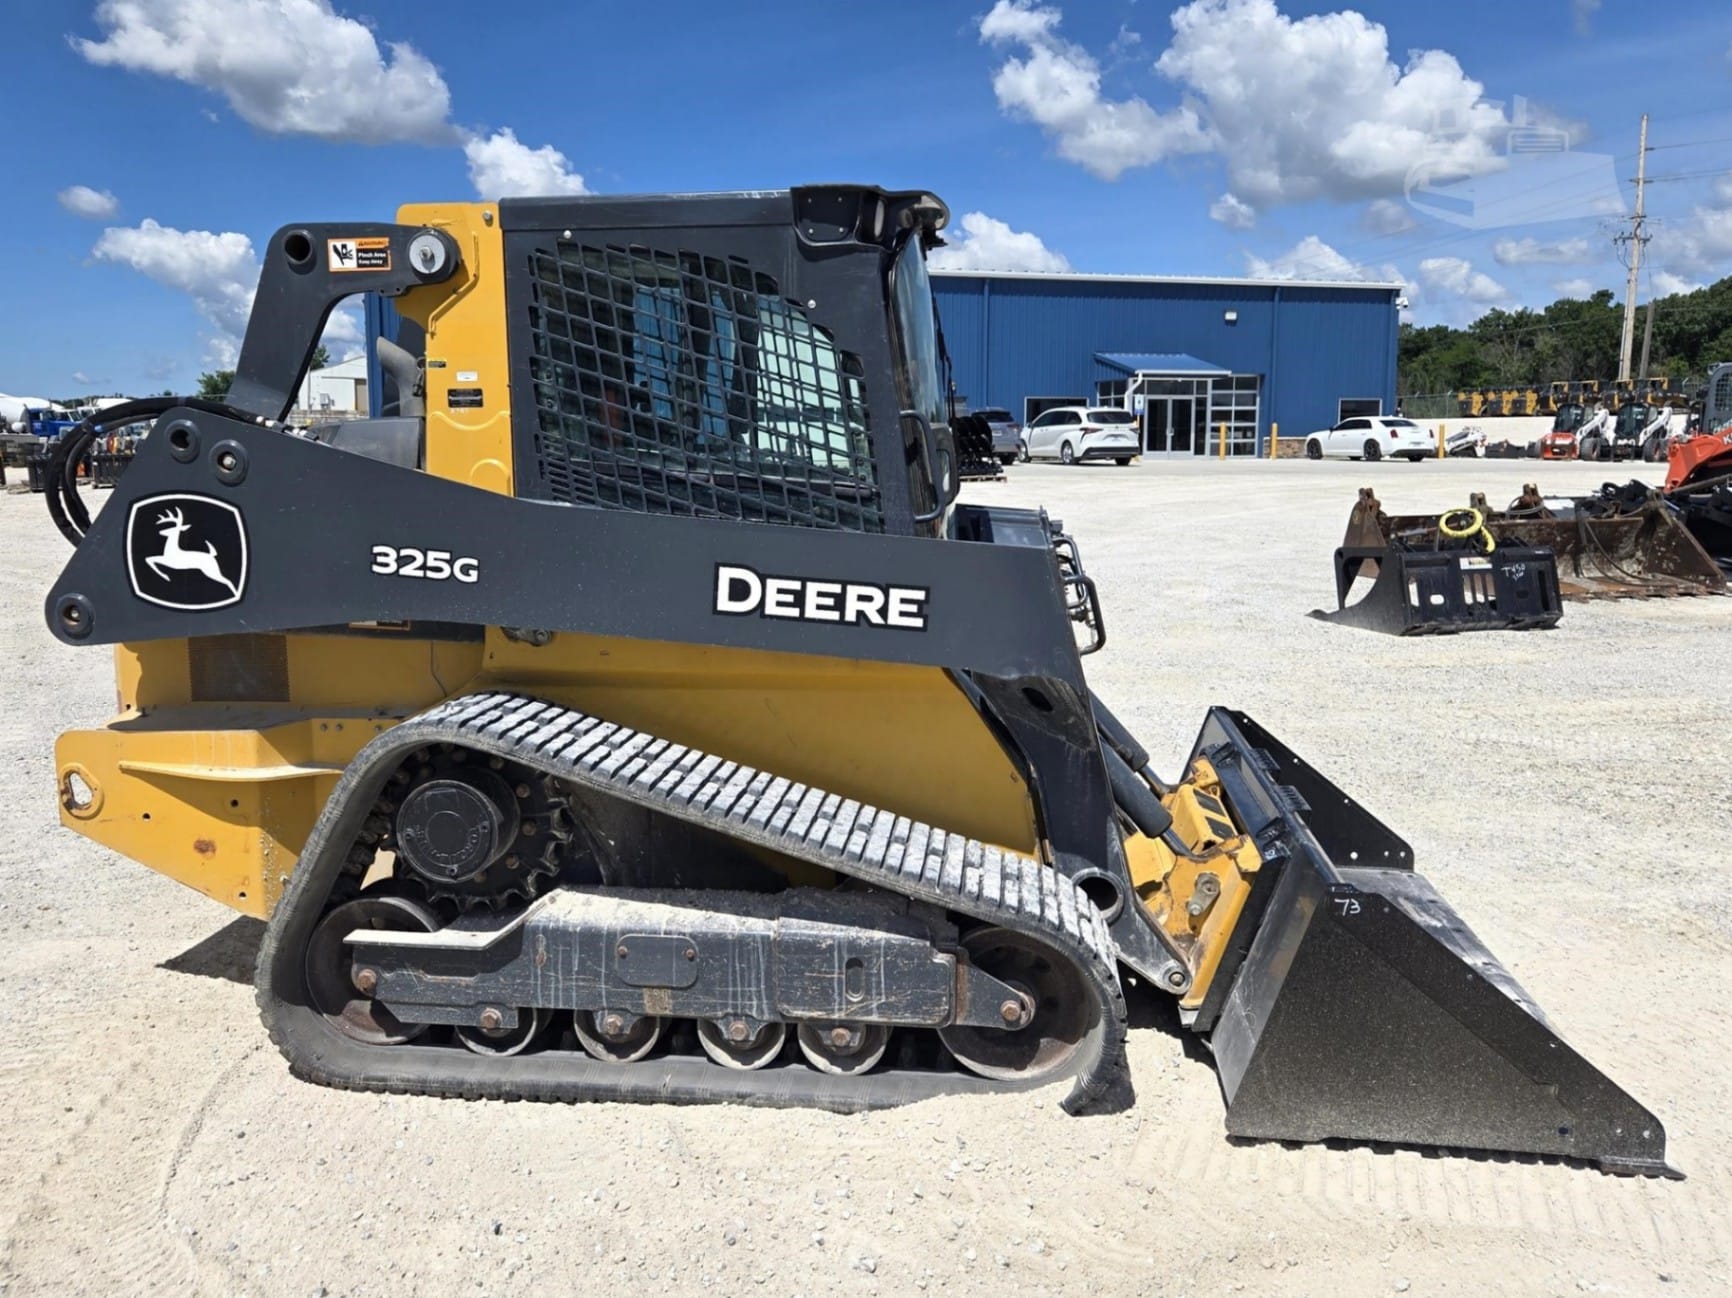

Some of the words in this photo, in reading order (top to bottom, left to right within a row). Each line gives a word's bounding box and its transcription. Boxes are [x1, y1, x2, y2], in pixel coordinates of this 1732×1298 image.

[371, 545, 480, 584] 325G
[715, 565, 928, 629] DEERE
[1334, 898, 1361, 917] 73
